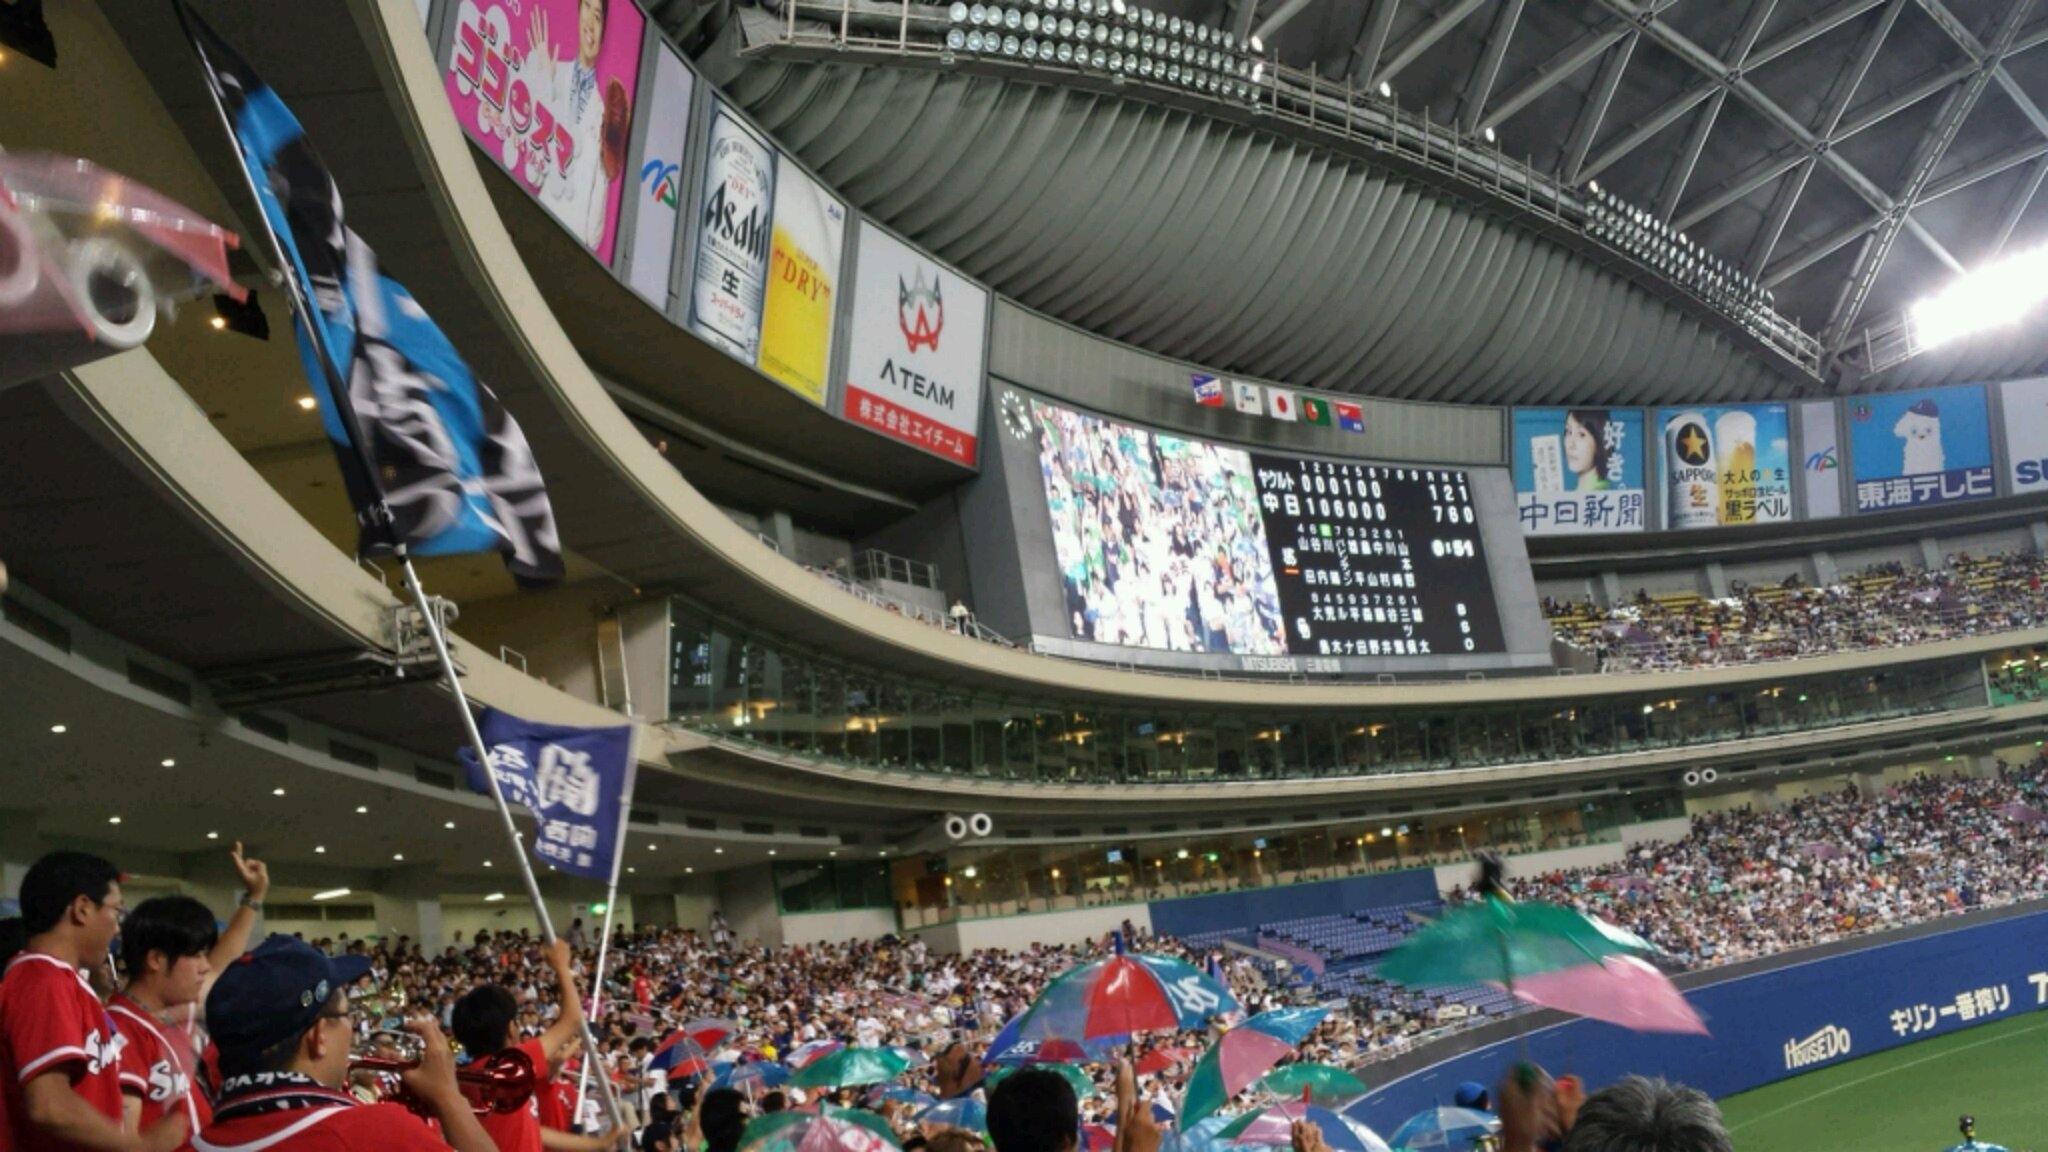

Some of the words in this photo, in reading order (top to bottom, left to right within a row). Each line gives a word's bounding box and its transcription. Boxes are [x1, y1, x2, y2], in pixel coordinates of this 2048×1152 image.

[704, 181, 769, 262] Asahi
[722, 268, 740, 299] 生
[860, 396, 964, 456] 株式会社エイチーム
[1857, 467, 1993, 510] 東海テレビ
[2016, 458, 2048, 485] S
[1519, 493, 1643, 531] 中日新聞
[1689, 484, 1709, 508] 生
[1725, 498, 1789, 520] 黒ラベル
[1889, 983, 2011, 1037] キリン一番搾り
